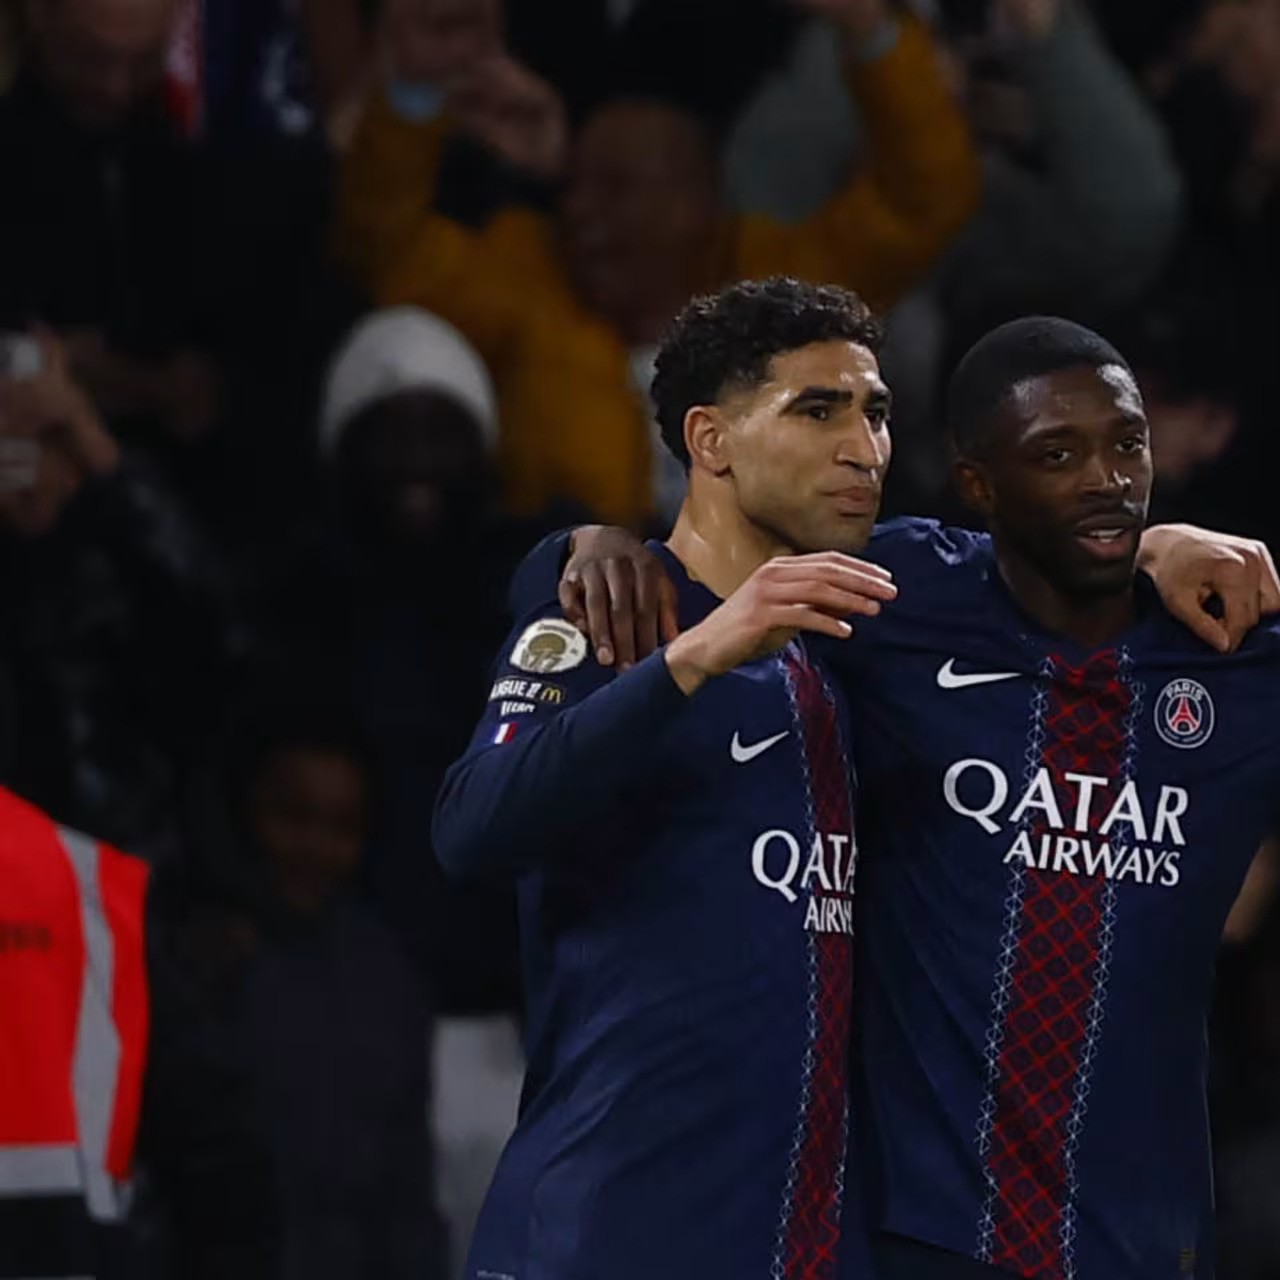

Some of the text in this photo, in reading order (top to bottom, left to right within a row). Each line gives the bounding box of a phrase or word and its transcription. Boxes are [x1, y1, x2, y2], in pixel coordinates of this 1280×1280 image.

[1166, 682, 1204, 701] PARIS
[943, 758, 1189, 846] QATAR
[752, 829, 857, 903] QATA
[1003, 831, 1180, 887] AIRWAYS
[803, 895, 854, 936] AIRW
